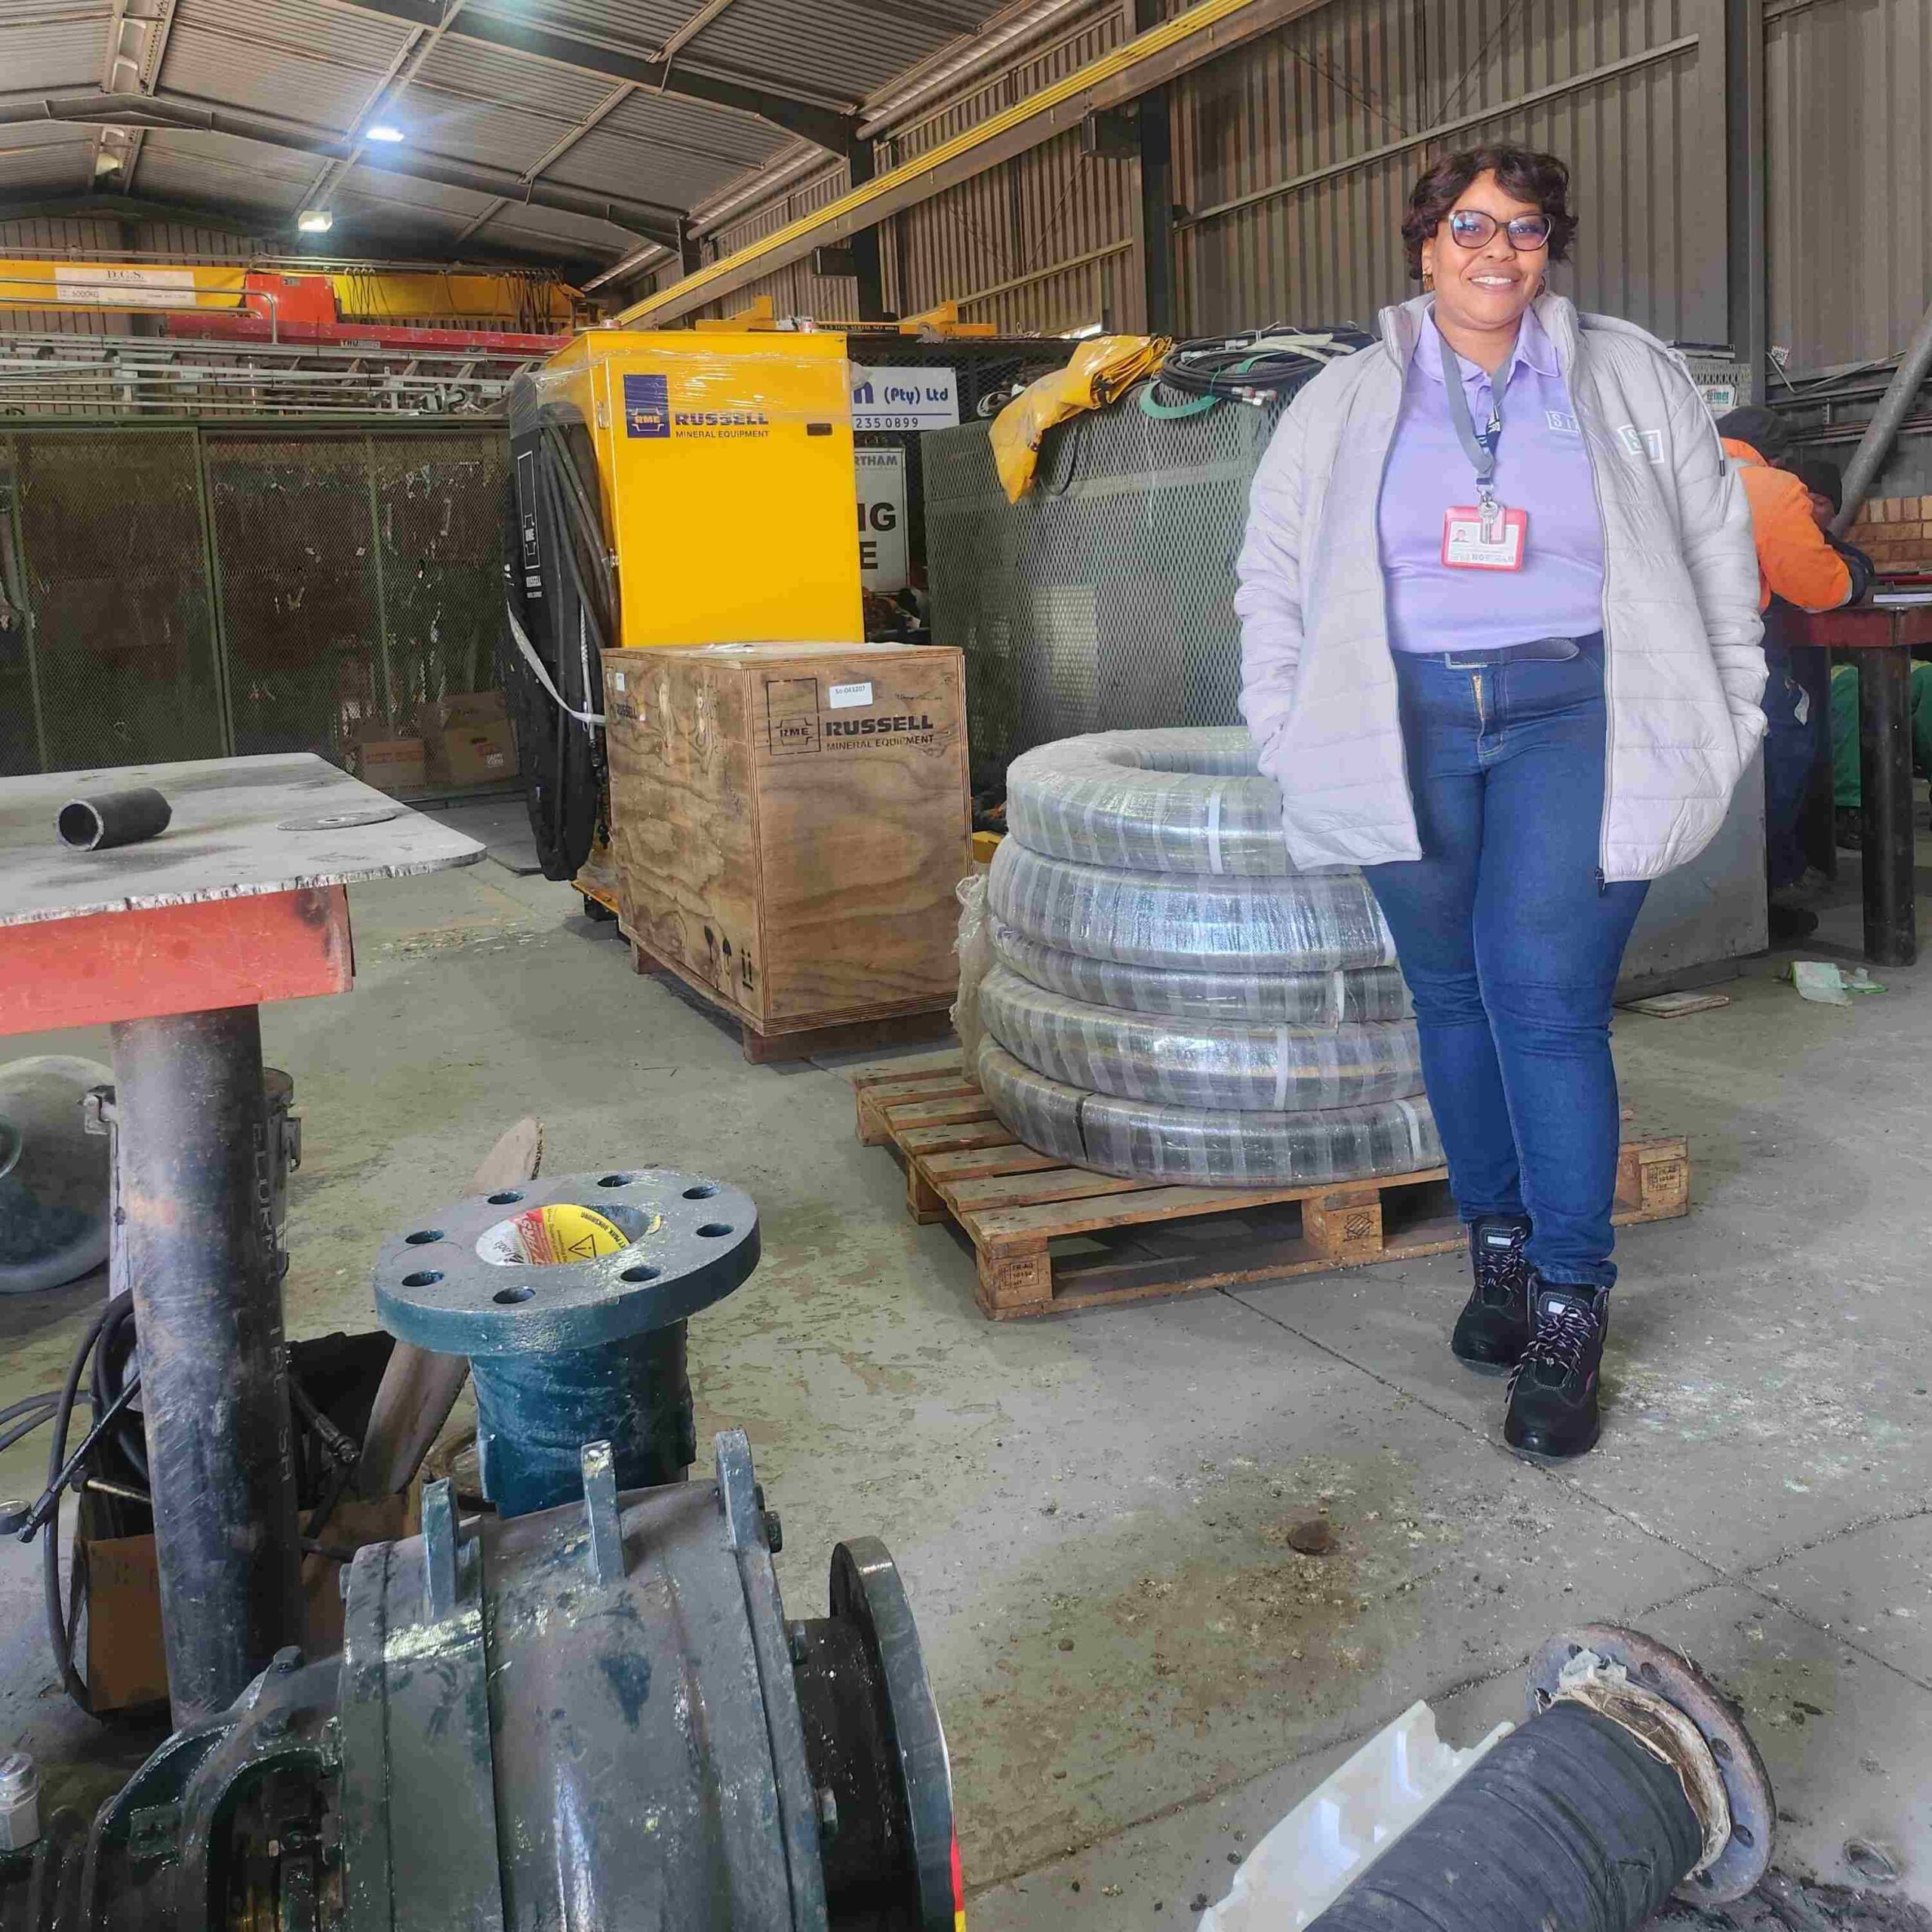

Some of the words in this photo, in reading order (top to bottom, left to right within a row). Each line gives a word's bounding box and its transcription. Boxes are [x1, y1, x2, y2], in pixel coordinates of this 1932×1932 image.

[884, 386, 920, 405] (Pty)
[926, 388, 948, 401] Ltd
[634, 415, 661, 423] RME
[675, 413, 769, 426] RUSSELL
[718, 430, 769, 438] EQUIPMENT
[780, 728, 810, 737] RME
[826, 716, 934, 737] RUSSELL
[827, 740, 871, 751] MINERAL
[875, 735, 934, 747] EQUIPMENT
